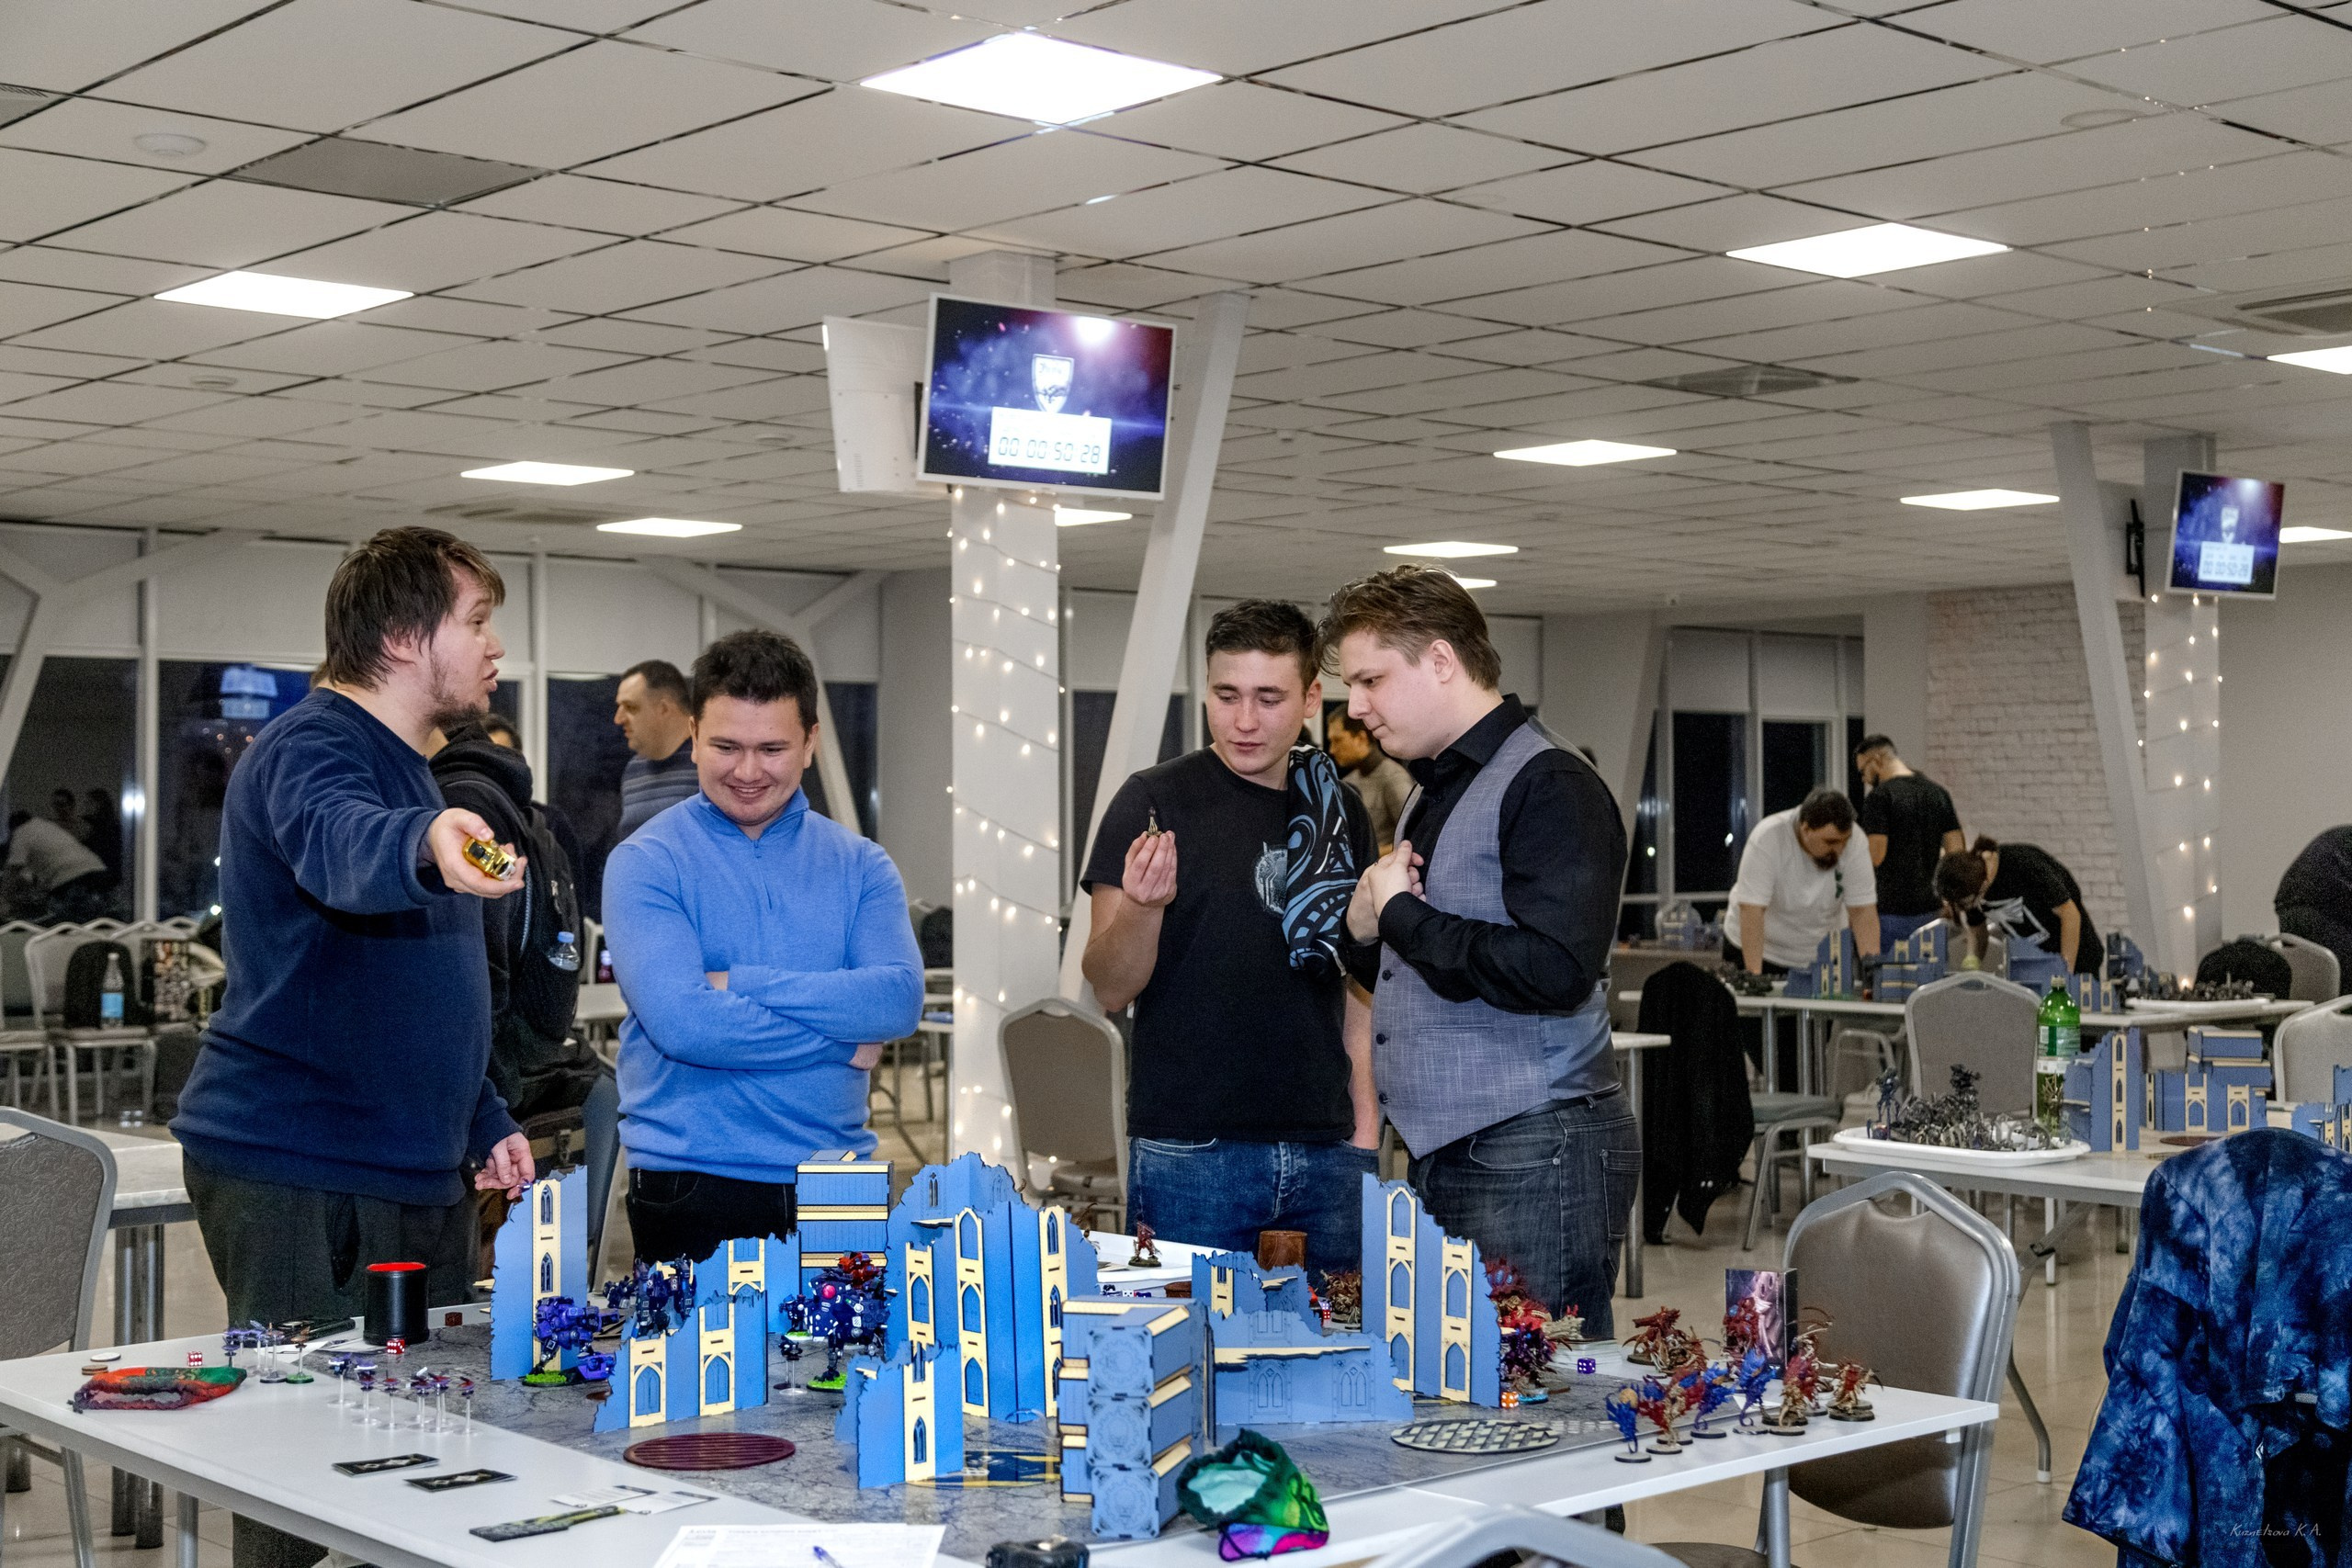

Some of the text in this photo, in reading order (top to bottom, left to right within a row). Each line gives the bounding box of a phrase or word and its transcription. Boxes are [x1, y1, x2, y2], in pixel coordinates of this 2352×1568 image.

[998, 436, 1020, 457] 00
[1026, 439, 1048, 459] 00
[1080, 445, 1101, 464] 28
